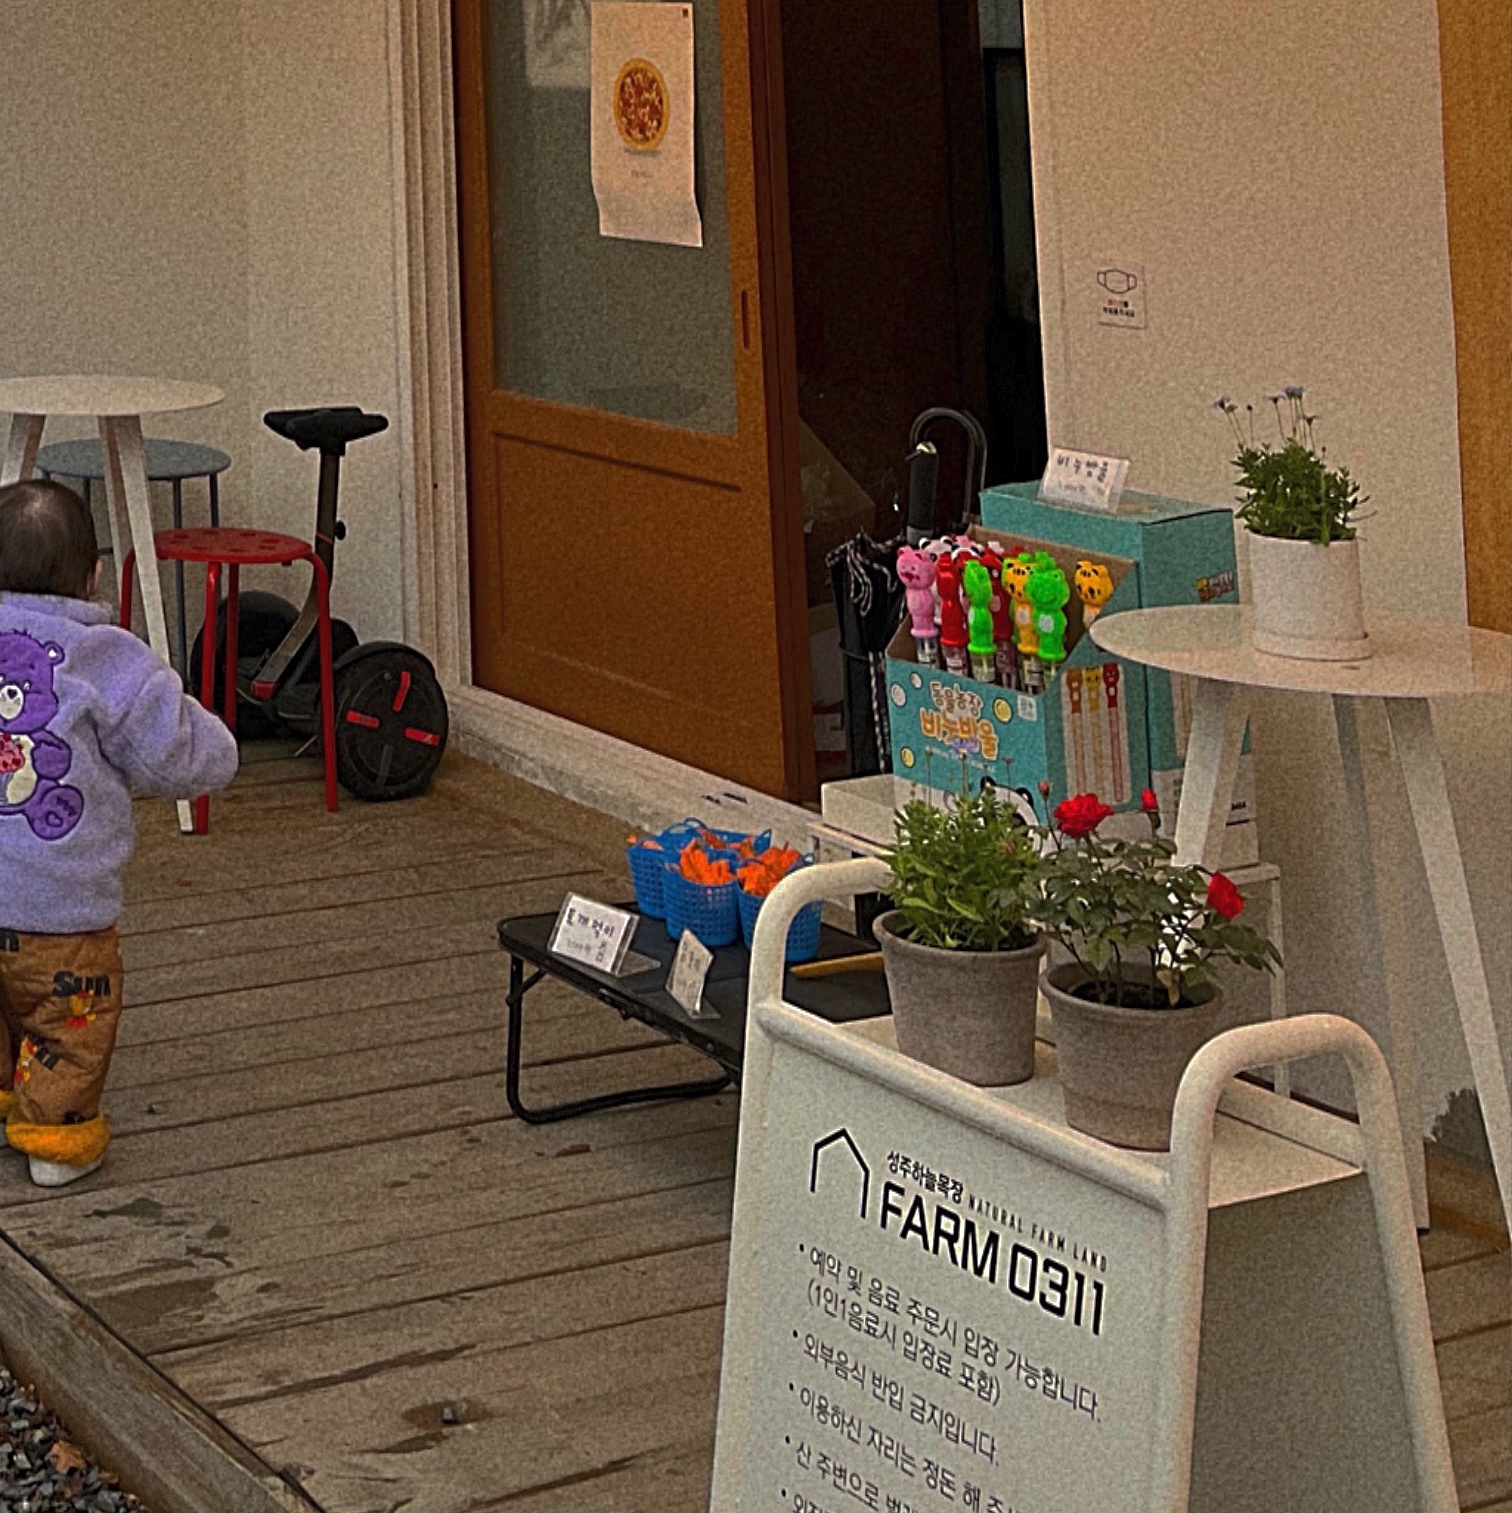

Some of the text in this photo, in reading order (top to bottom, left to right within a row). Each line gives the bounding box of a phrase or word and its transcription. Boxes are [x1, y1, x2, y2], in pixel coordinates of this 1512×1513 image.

[887, 1150, 963, 1204] 성주하늘목장
[968, 1194, 1107, 1273] NATURAL FARM LAND
[880, 1181, 1104, 1336] FARM 0311
[808, 1278, 1000, 1407] (1인1음료시 입장료 포함)
[810, 1246, 1101, 1423] 예약 및 음료 주문시 입장 가능합니다.
[800, 1387, 862, 1445] 이용하신
[866, 1425, 916, 1478] 자리는
[923, 1457, 956, 1502] 정돈
[963, 1481, 982, 1513] 해
[804, 1333, 999, 1467] 외부음식 반입 금지입니다.
[796, 1441, 812, 1470] 산
[817, 1451, 879, 1512] 주변으로
